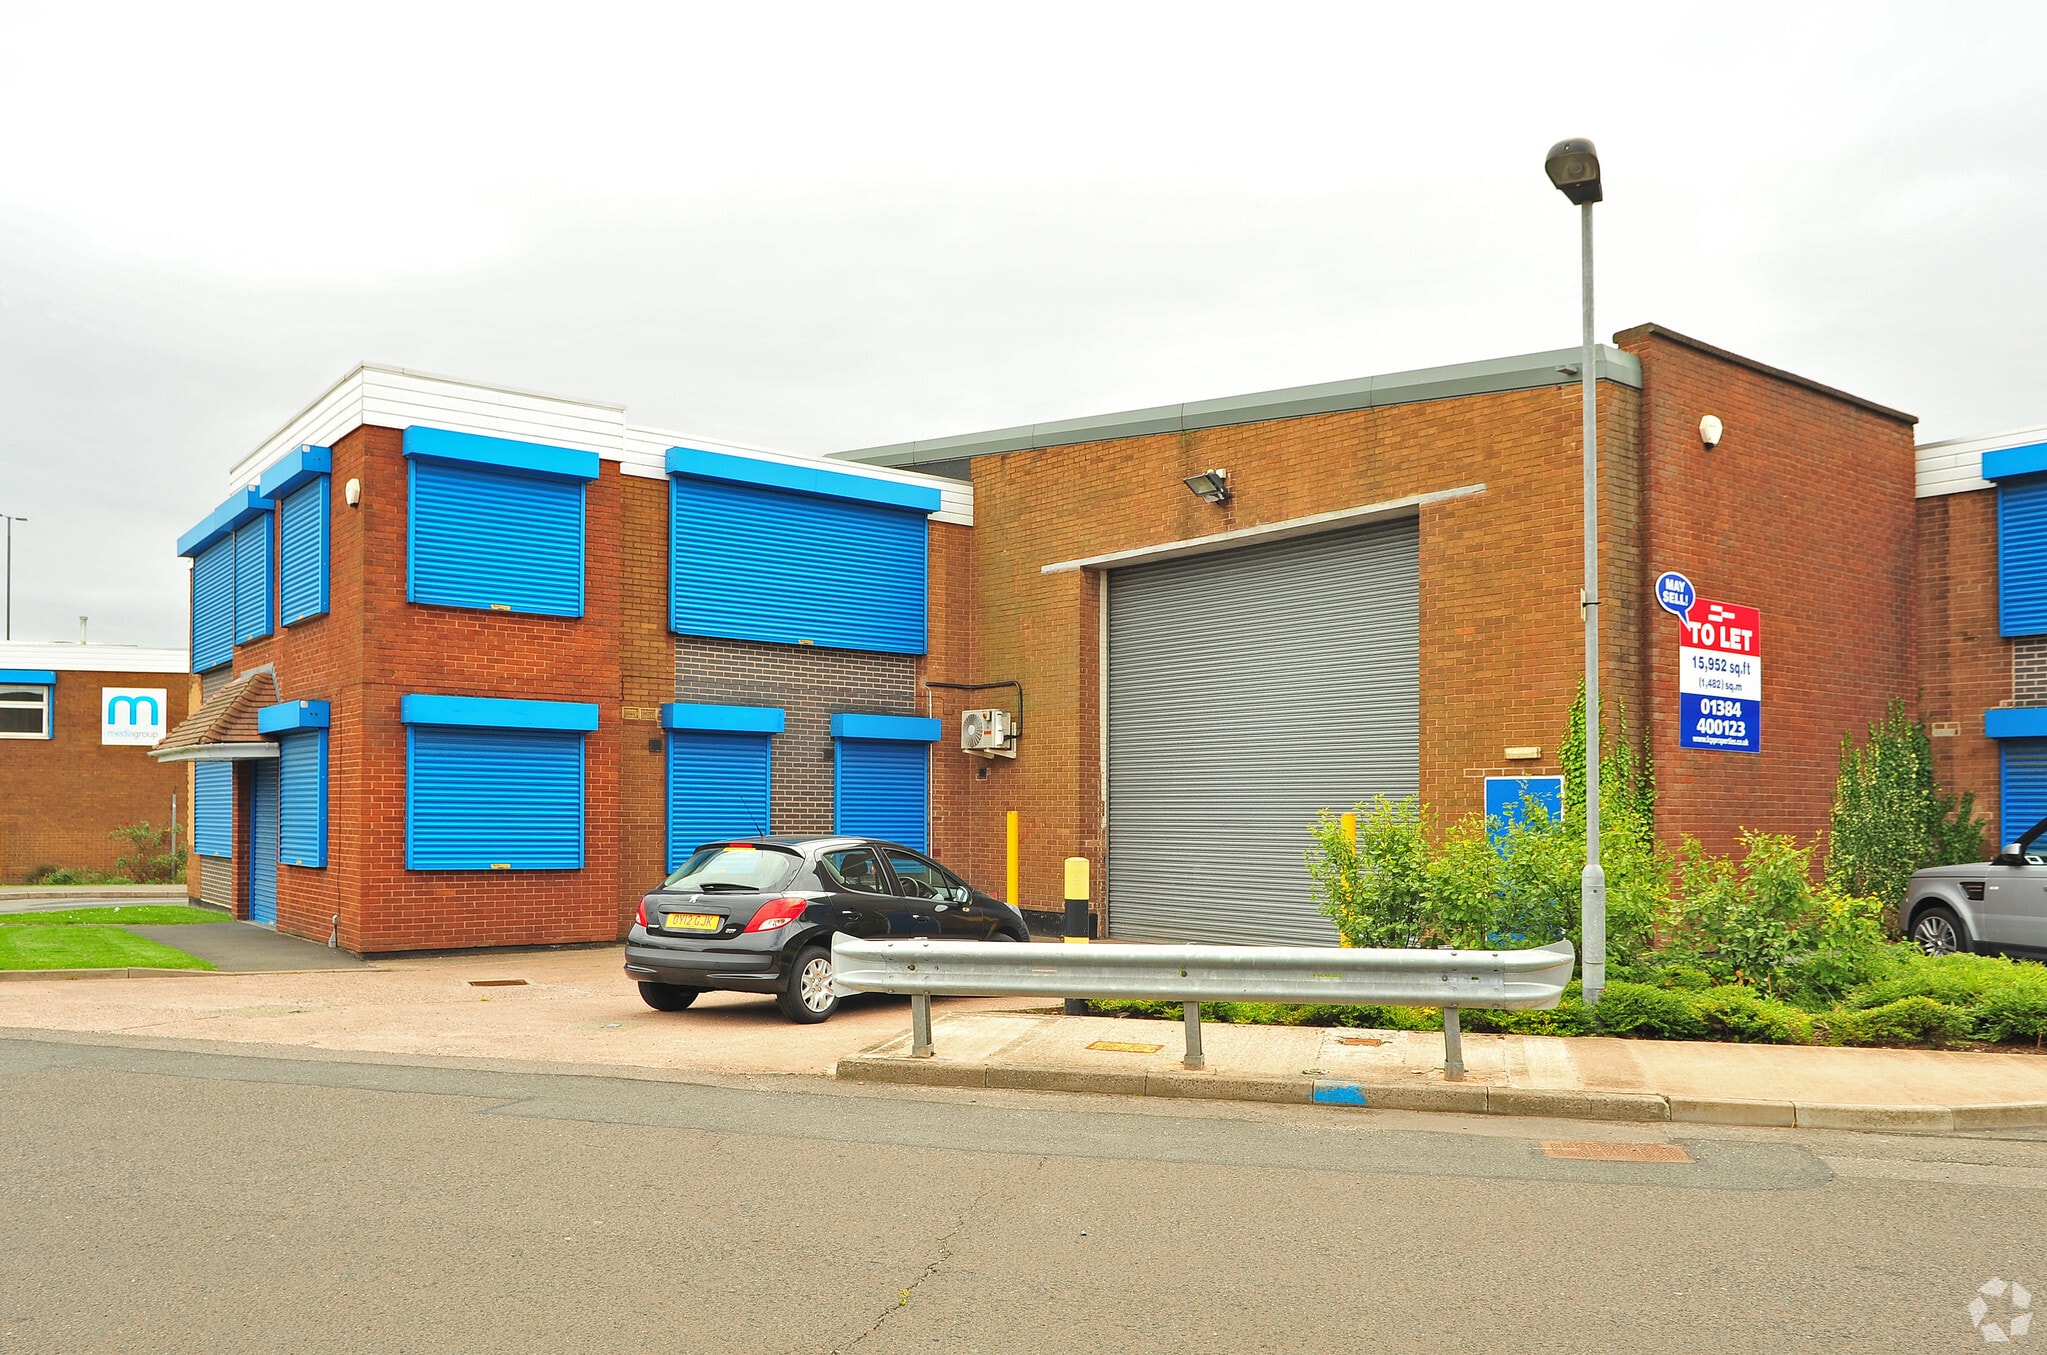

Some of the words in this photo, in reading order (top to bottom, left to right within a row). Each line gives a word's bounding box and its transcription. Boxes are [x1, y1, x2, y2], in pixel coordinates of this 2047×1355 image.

[1665, 578, 1685, 593] MAY
[1662, 590, 1689, 606] SELL!
[1689, 621, 1715, 646] TO
[1720, 626, 1753, 652] LET
[1692, 655, 1727, 673] 15,952
[1729, 661, 1751, 678] sq.ft
[1698, 677, 1724, 690] (1,482)
[1725, 682, 1743, 693] sq.m
[1700, 698, 1742, 718] 01384
[107, 730, 159, 739] mediagroup
[1696, 717, 1746, 737] 400123
